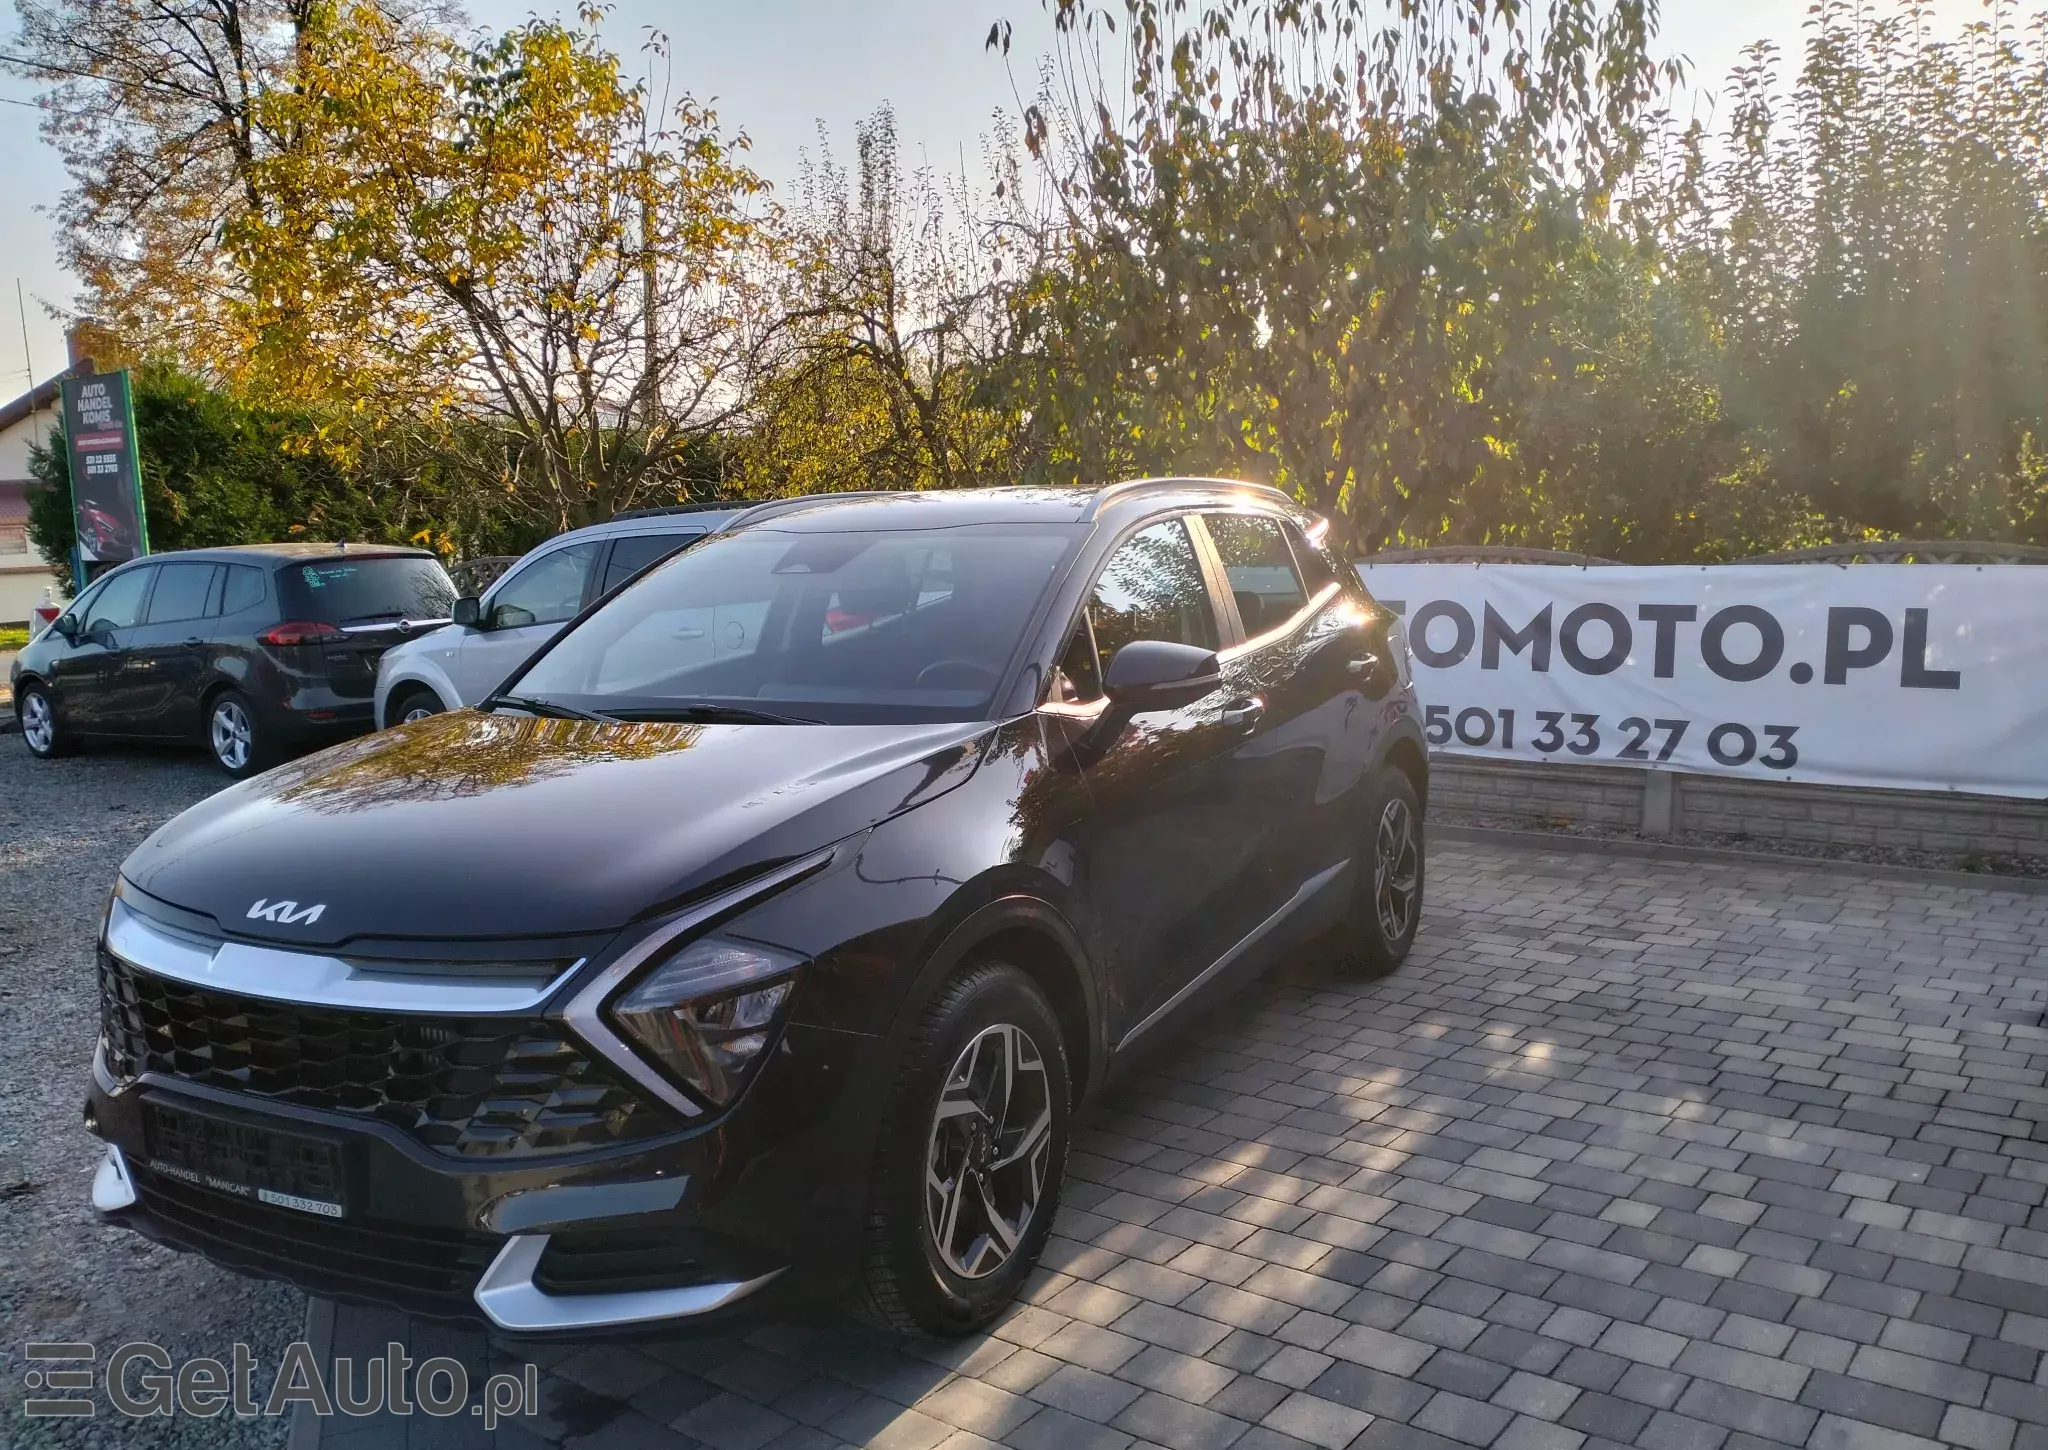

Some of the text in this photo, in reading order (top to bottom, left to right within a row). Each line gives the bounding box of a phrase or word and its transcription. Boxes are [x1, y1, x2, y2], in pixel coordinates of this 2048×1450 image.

[82, 383, 105, 398] AUTO
[77, 396, 113, 412] HANDEL
[82, 410, 111, 424] KOMIS
[1425, 704, 1800, 770] 501 33 27 03
[246, 898, 327, 925] KIA
[150, 1160, 200, 1183] AUTO-HANDEL
[271, 1193, 338, 1216] 501 332 703
